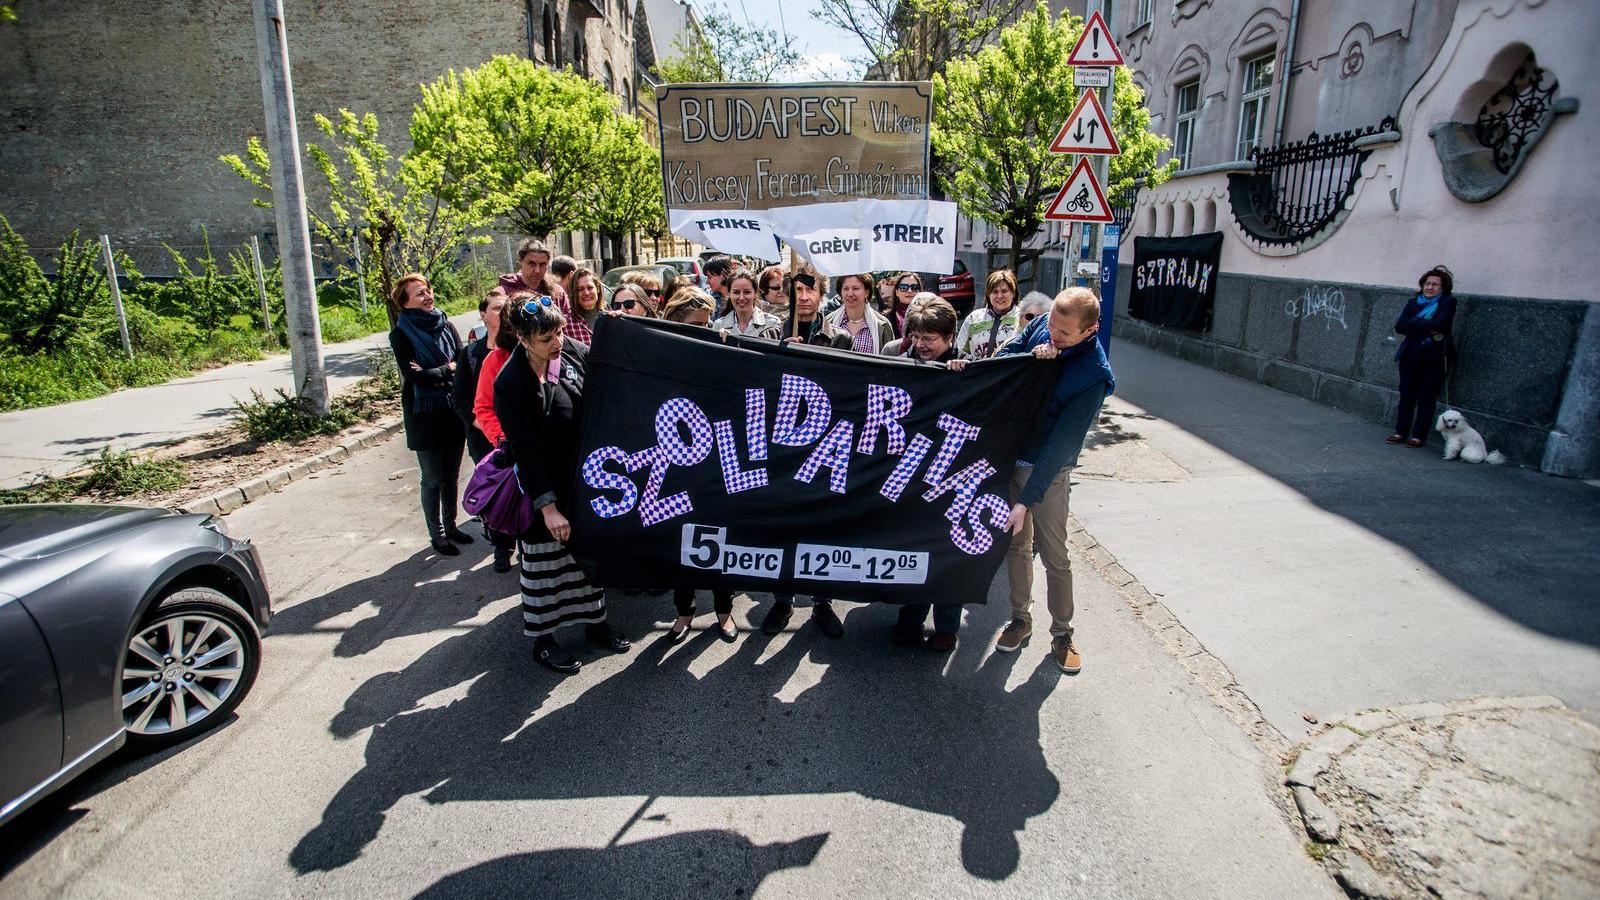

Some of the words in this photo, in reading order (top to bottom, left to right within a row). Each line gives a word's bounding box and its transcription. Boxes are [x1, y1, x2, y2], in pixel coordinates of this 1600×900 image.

[679, 96, 857, 143] BUDAPEST
[665, 160, 751, 210] Kölcsey
[754, 157, 819, 200] Ferenc
[825, 155, 923, 197] Gimnázium
[809, 236, 861, 255] GRÈVE
[872, 223, 944, 245] STREIK
[1137, 256, 1213, 296] SZTRAJK
